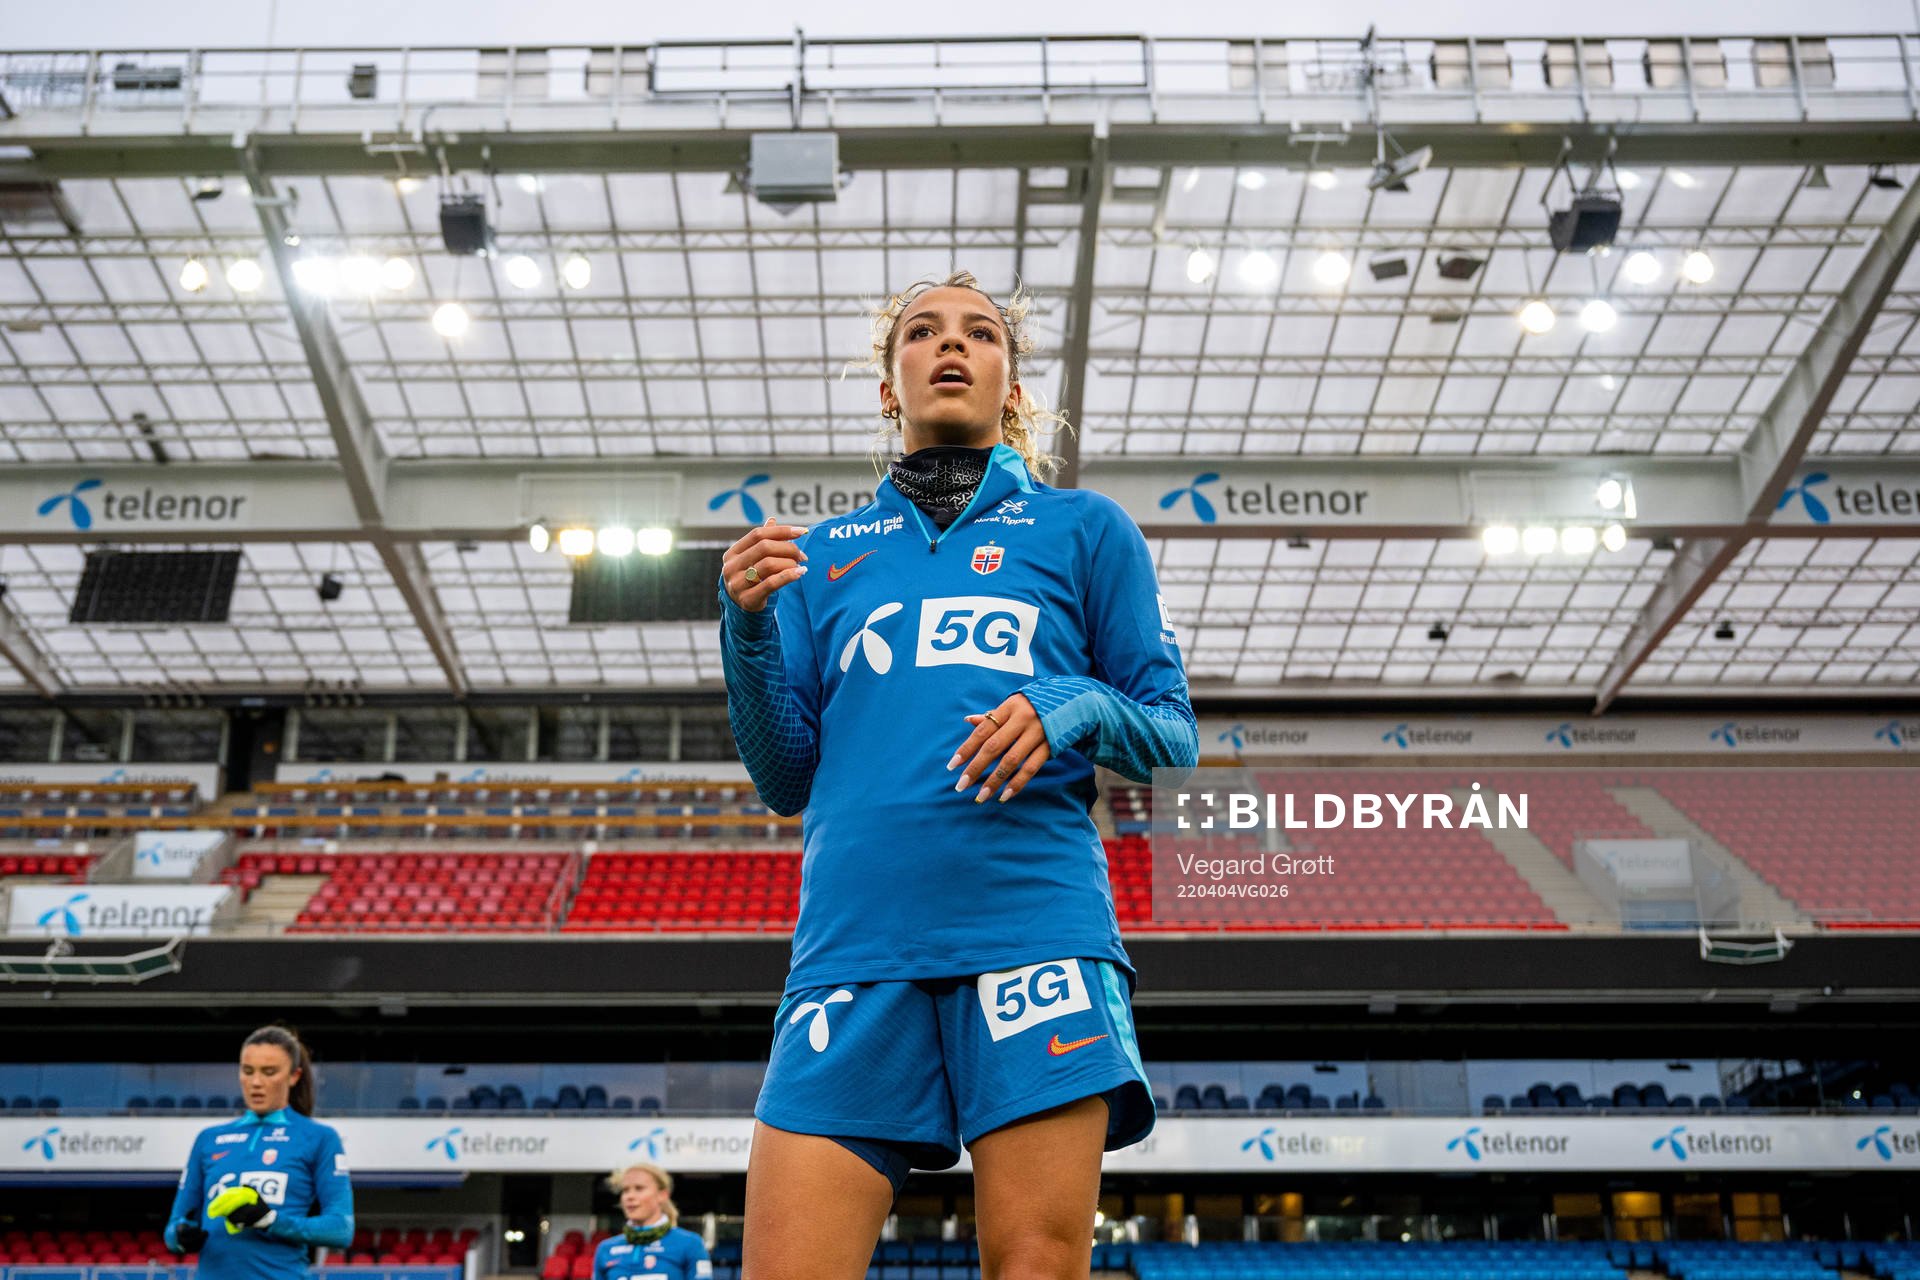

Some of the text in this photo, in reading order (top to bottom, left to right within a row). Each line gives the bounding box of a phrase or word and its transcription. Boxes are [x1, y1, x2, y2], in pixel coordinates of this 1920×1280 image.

[104, 488, 245, 521] telenor
[775, 483, 875, 515] telen
[1224, 482, 1368, 515] telenor
[829, 519, 880, 539] KIWI
[974, 515, 1036, 526] Norsk Tipping
[930, 609, 1021, 657] 5G
[1244, 727, 1309, 745] telenor
[1408, 727, 1473, 745] telenor
[1572, 726, 1637, 743] telenor
[1735, 725, 1800, 743] telenor
[89, 901, 204, 928] telenor
[996, 964, 1070, 1022] 5G
[59, 1130, 145, 1155] telenor
[462, 1129, 548, 1153] telenor
[1482, 1130, 1569, 1154] telenor
